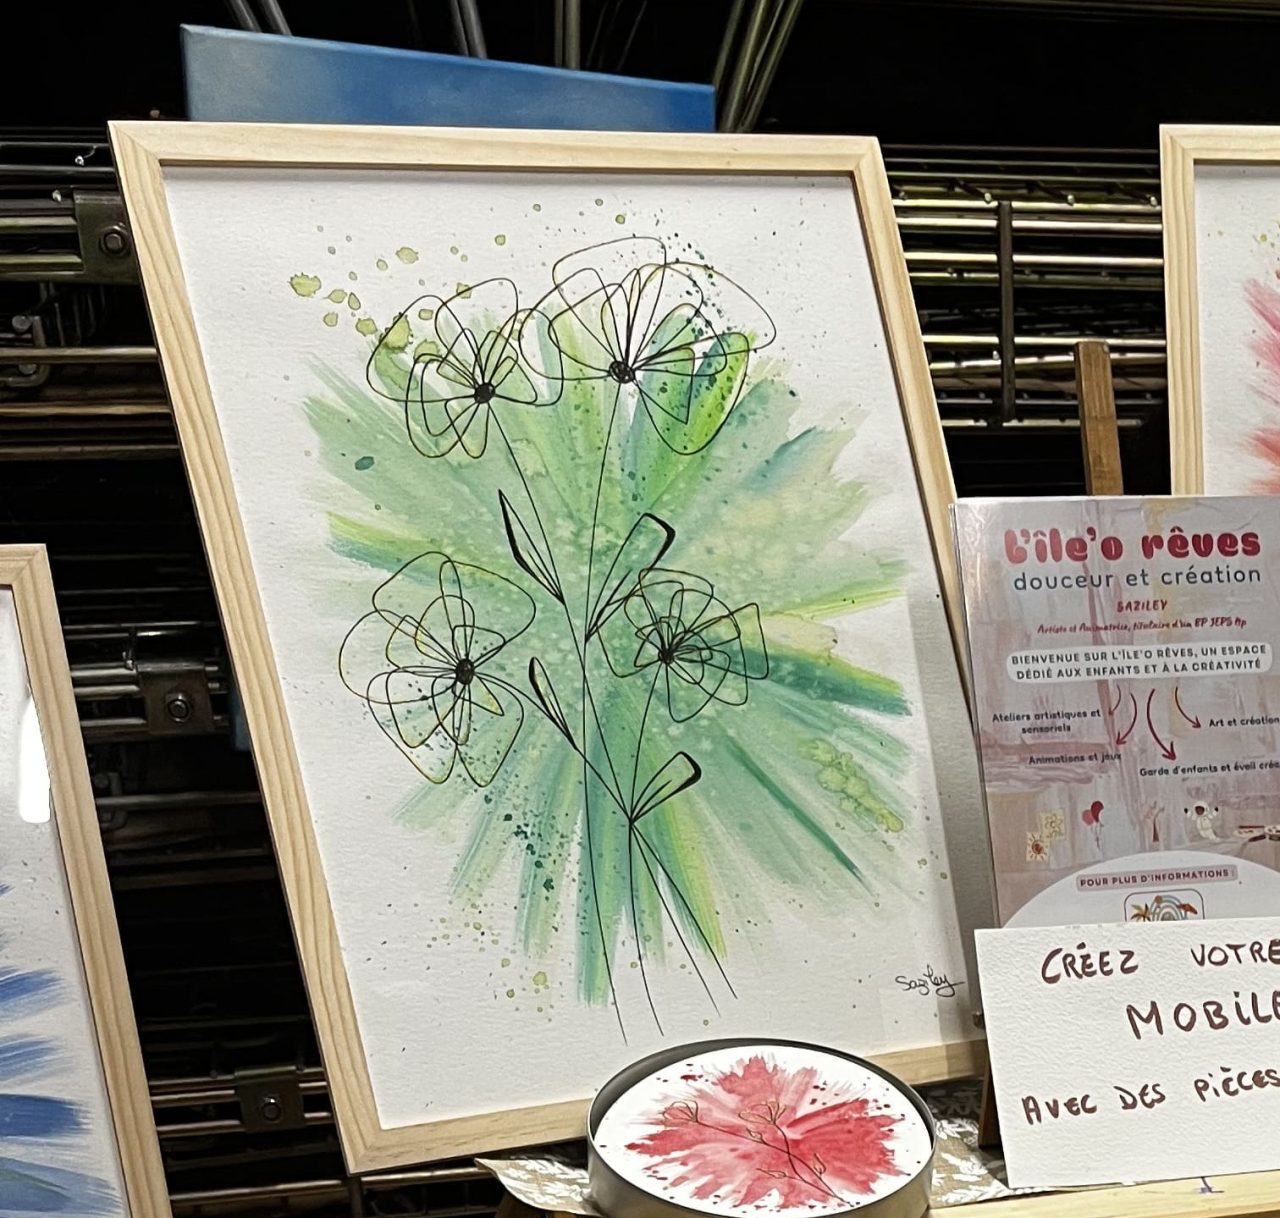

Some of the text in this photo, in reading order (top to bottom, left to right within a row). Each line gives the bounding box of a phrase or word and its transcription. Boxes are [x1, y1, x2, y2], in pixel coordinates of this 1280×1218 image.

[1141, 525, 1261, 560] rêves
[1014, 564, 1261, 591] douceur et création
[1011, 652, 1080, 666] BIENVENUE
[1084, 651, 1108, 662] SUR
[1157, 645, 1199, 659] RÊVES,
[1201, 646, 1218, 657] UN
[1221, 644, 1267, 656] ESPACE
[1016, 657, 1261, 680] DÉDIÉ AUX ENFANTS ET À LA CRÉATIVITÉ
[992, 708, 1101, 723] Ateliers artistiques et
[1208, 714, 1280, 728] Art et création
[1021, 724, 1072, 734] sensoriels
[1028, 751, 1121, 765] Animations et jeux
[1139, 765, 1170, 777] Garde
[1172, 763, 1218, 775] d'enfants
[1221, 762, 1231, 772] et
[1234, 761, 1257, 772] éveil
[1080, 878, 1109, 887] POUR
[1112, 875, 1137, 884] PLUS
[1140, 868, 1230, 883] D'INFORMATIONS
[1041, 941, 1139, 985] CRÉEZ
[1020, 1094, 1098, 1126] AVEC
[1113, 1082, 1167, 1111] DES
